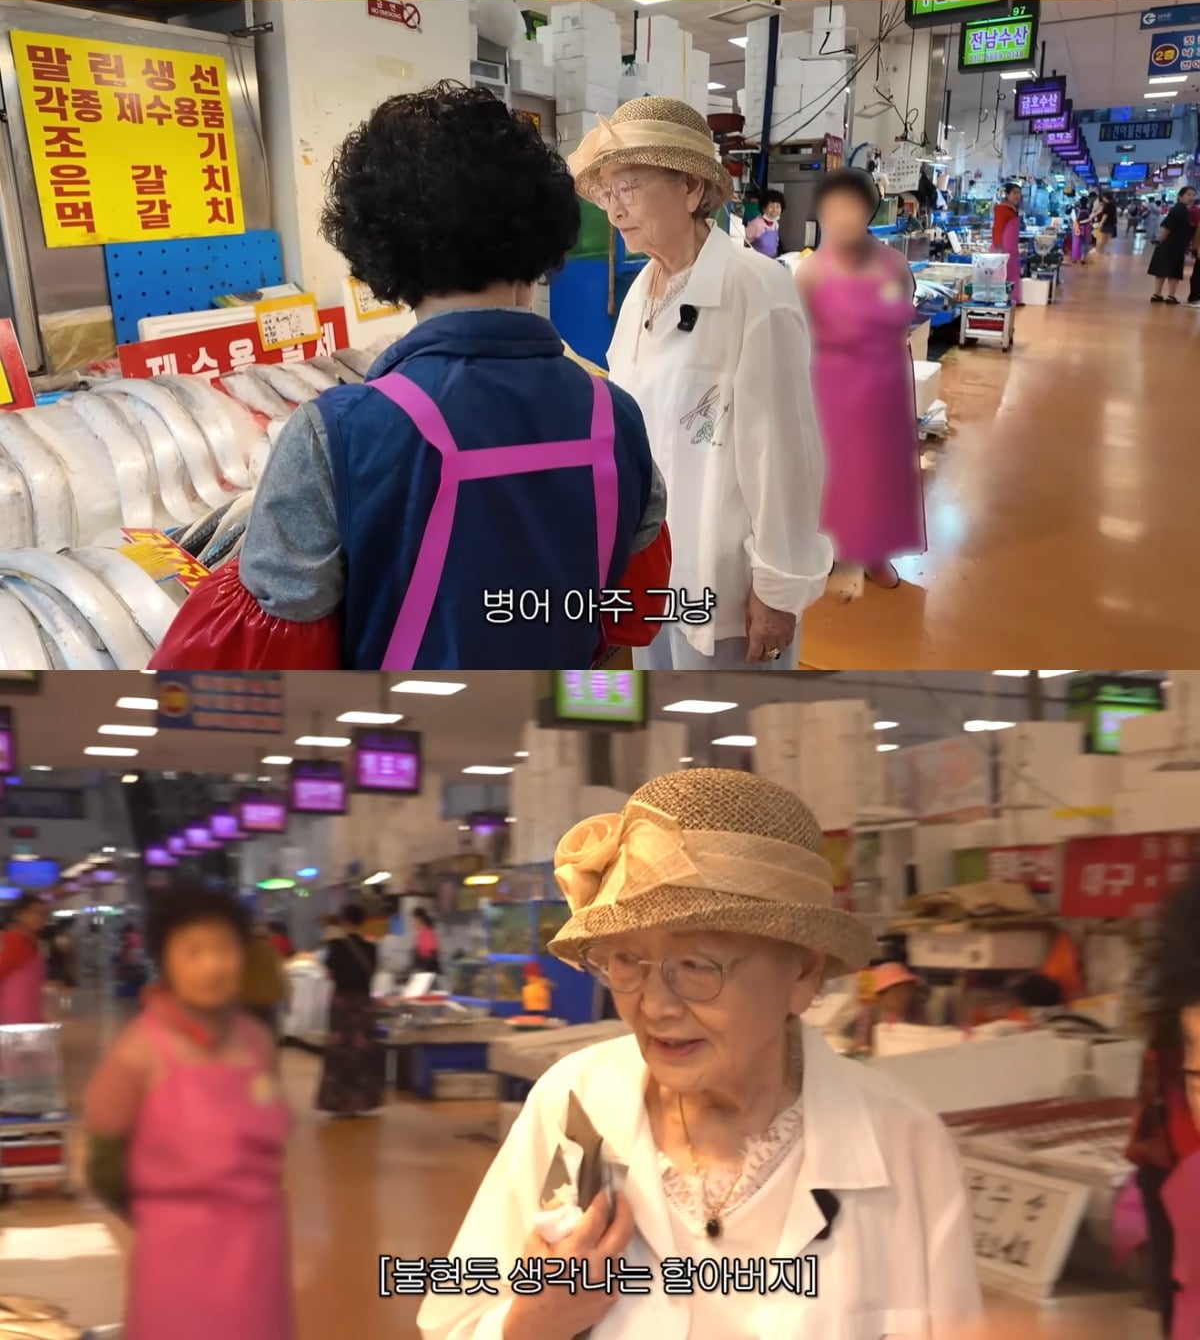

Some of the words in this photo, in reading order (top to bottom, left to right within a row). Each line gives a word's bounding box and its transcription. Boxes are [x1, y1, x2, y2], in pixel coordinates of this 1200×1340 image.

[970, 25, 1028, 51] 전남수산
[33, 85, 102, 123] 각종
[114, 92, 225, 129] 제수용품
[1021, 93, 1058, 109] 금호수산
